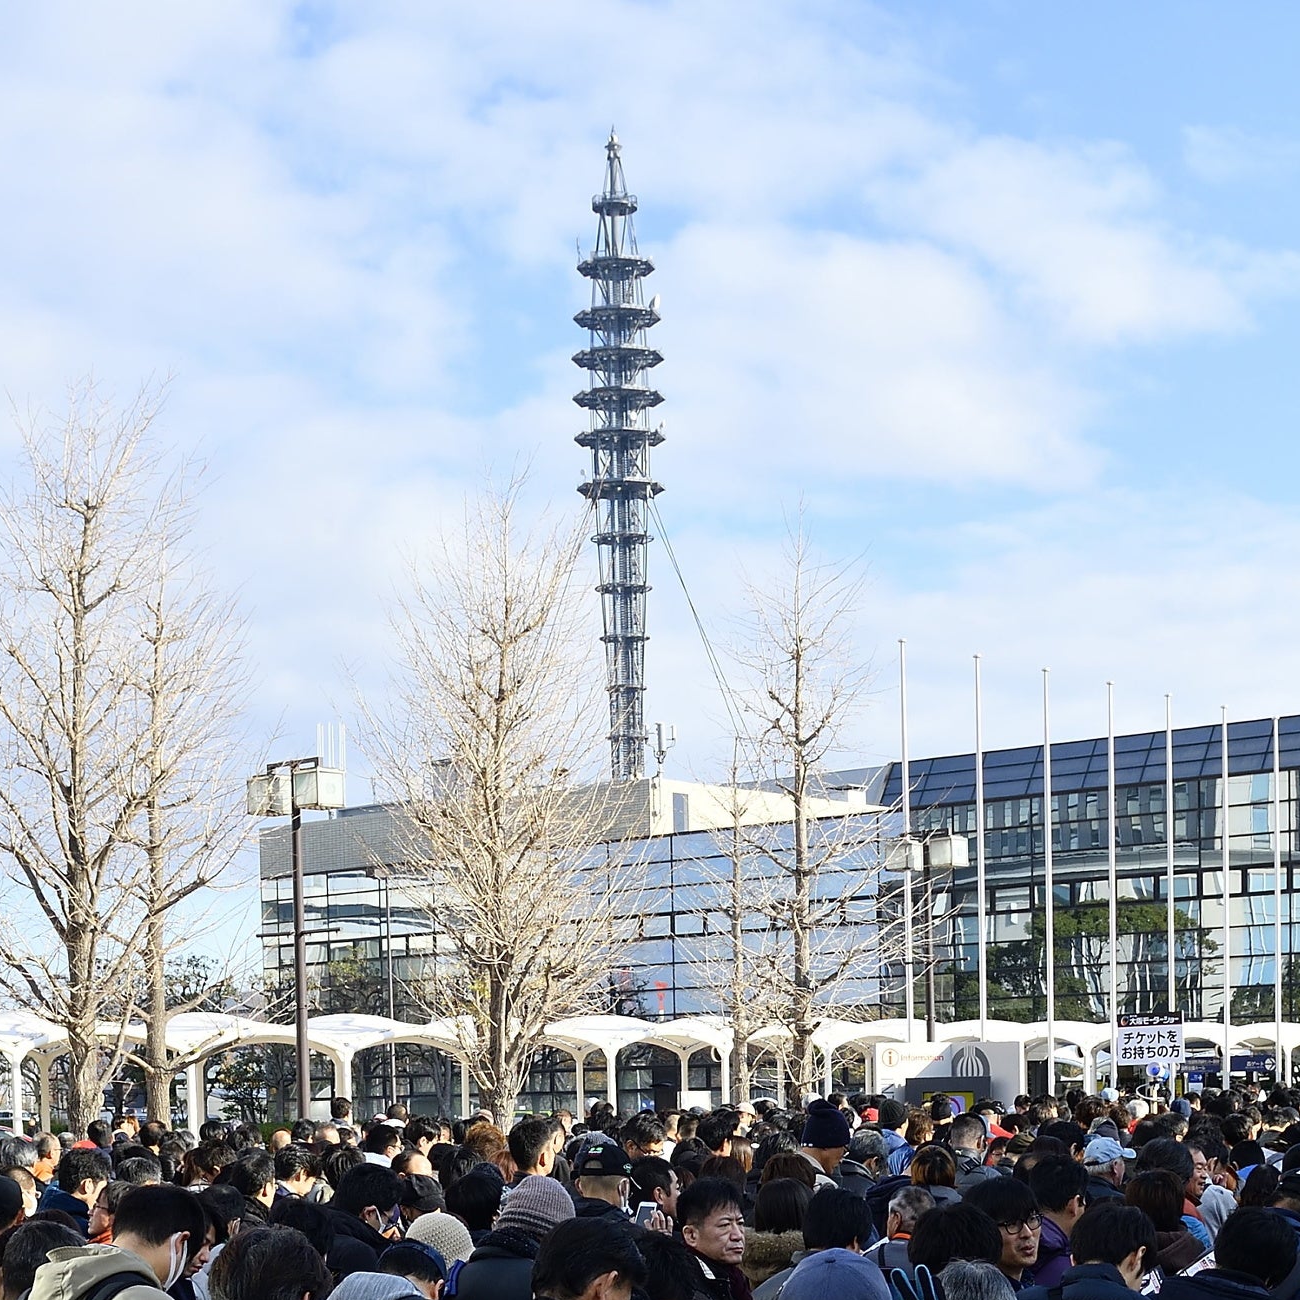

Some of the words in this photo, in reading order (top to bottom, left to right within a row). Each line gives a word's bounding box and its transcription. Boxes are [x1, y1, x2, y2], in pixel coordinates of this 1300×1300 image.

[1123, 1030, 1177, 1045] チケットを
[1122, 1044, 1180, 1060] お持ちの方
